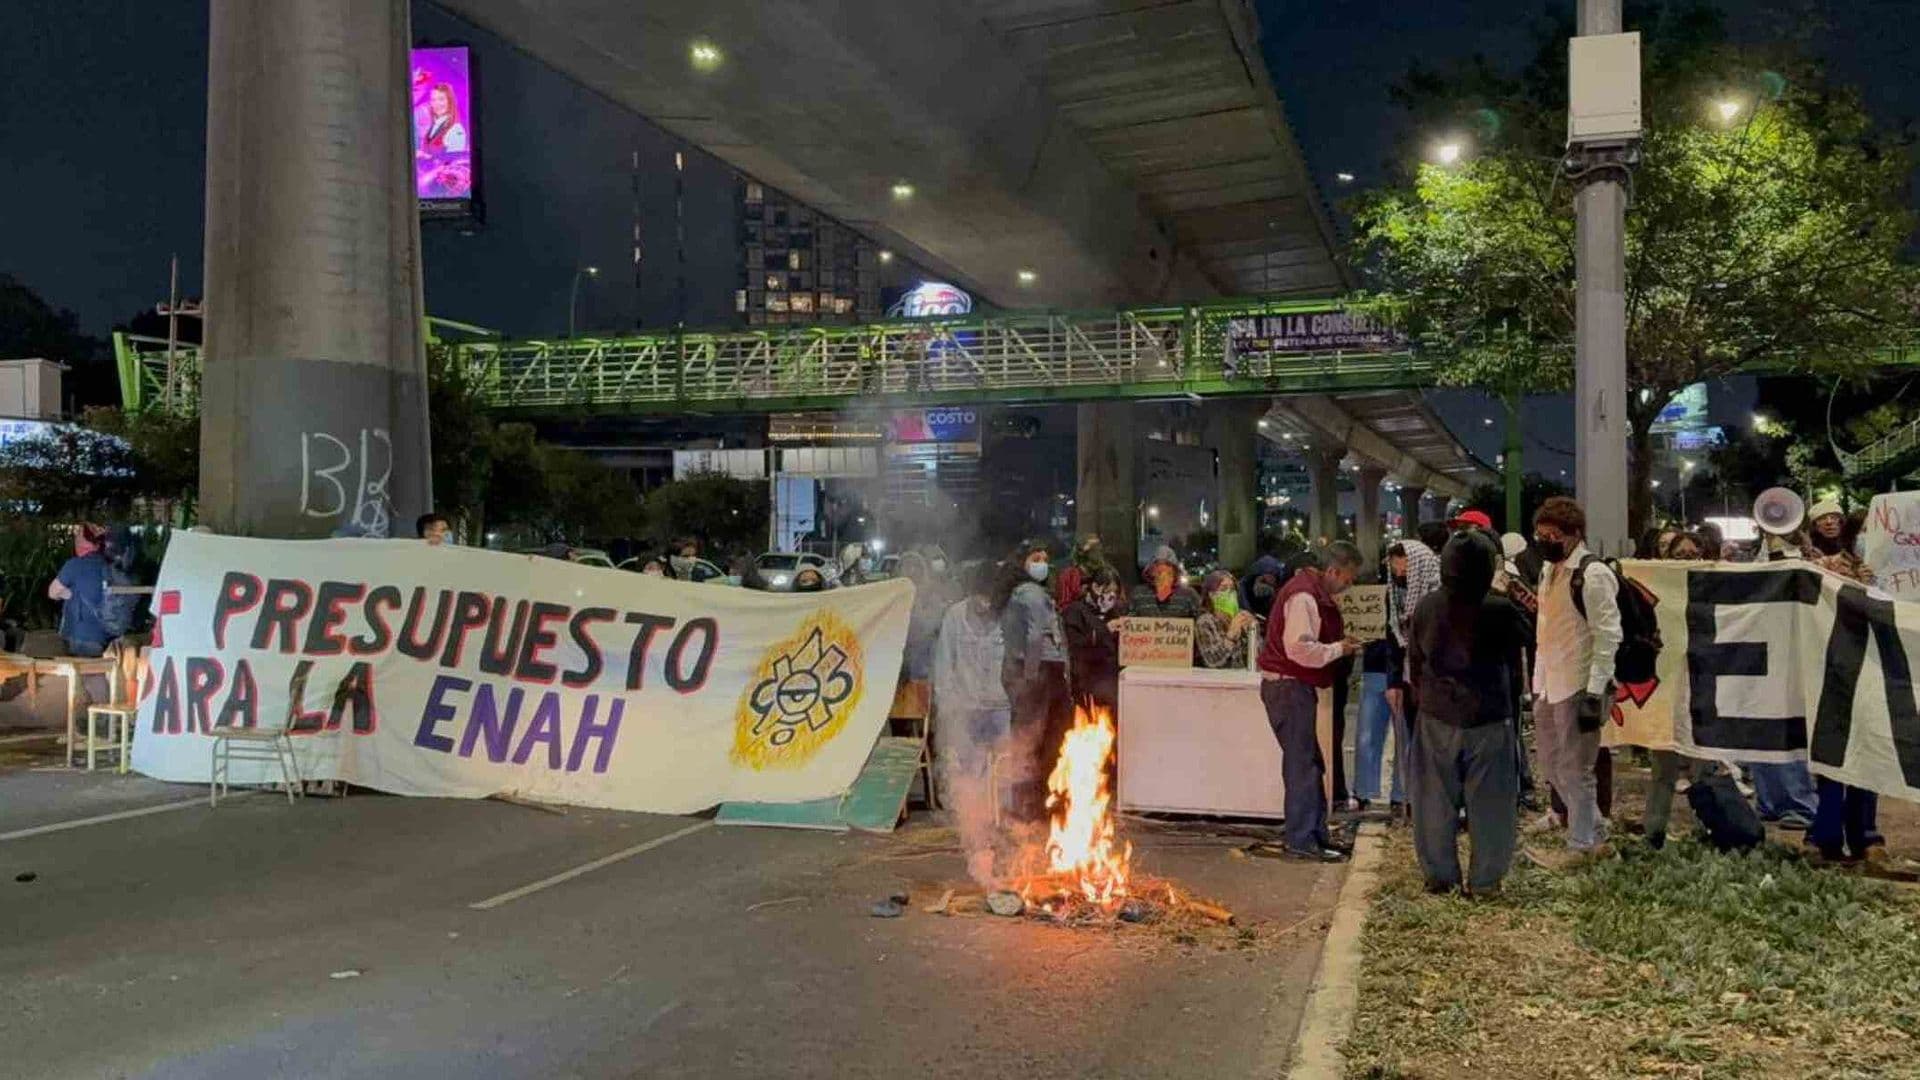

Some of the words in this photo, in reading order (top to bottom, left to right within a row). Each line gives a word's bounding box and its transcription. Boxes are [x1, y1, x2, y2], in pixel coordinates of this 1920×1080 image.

[928, 412, 976, 425] COSTO
[1874, 498, 1900, 534] NO
[213, 571, 720, 695] PRESUPUESTO
[140, 650, 258, 736] ARA
[286, 660, 377, 736] LA
[414, 674, 626, 774] ENAH
